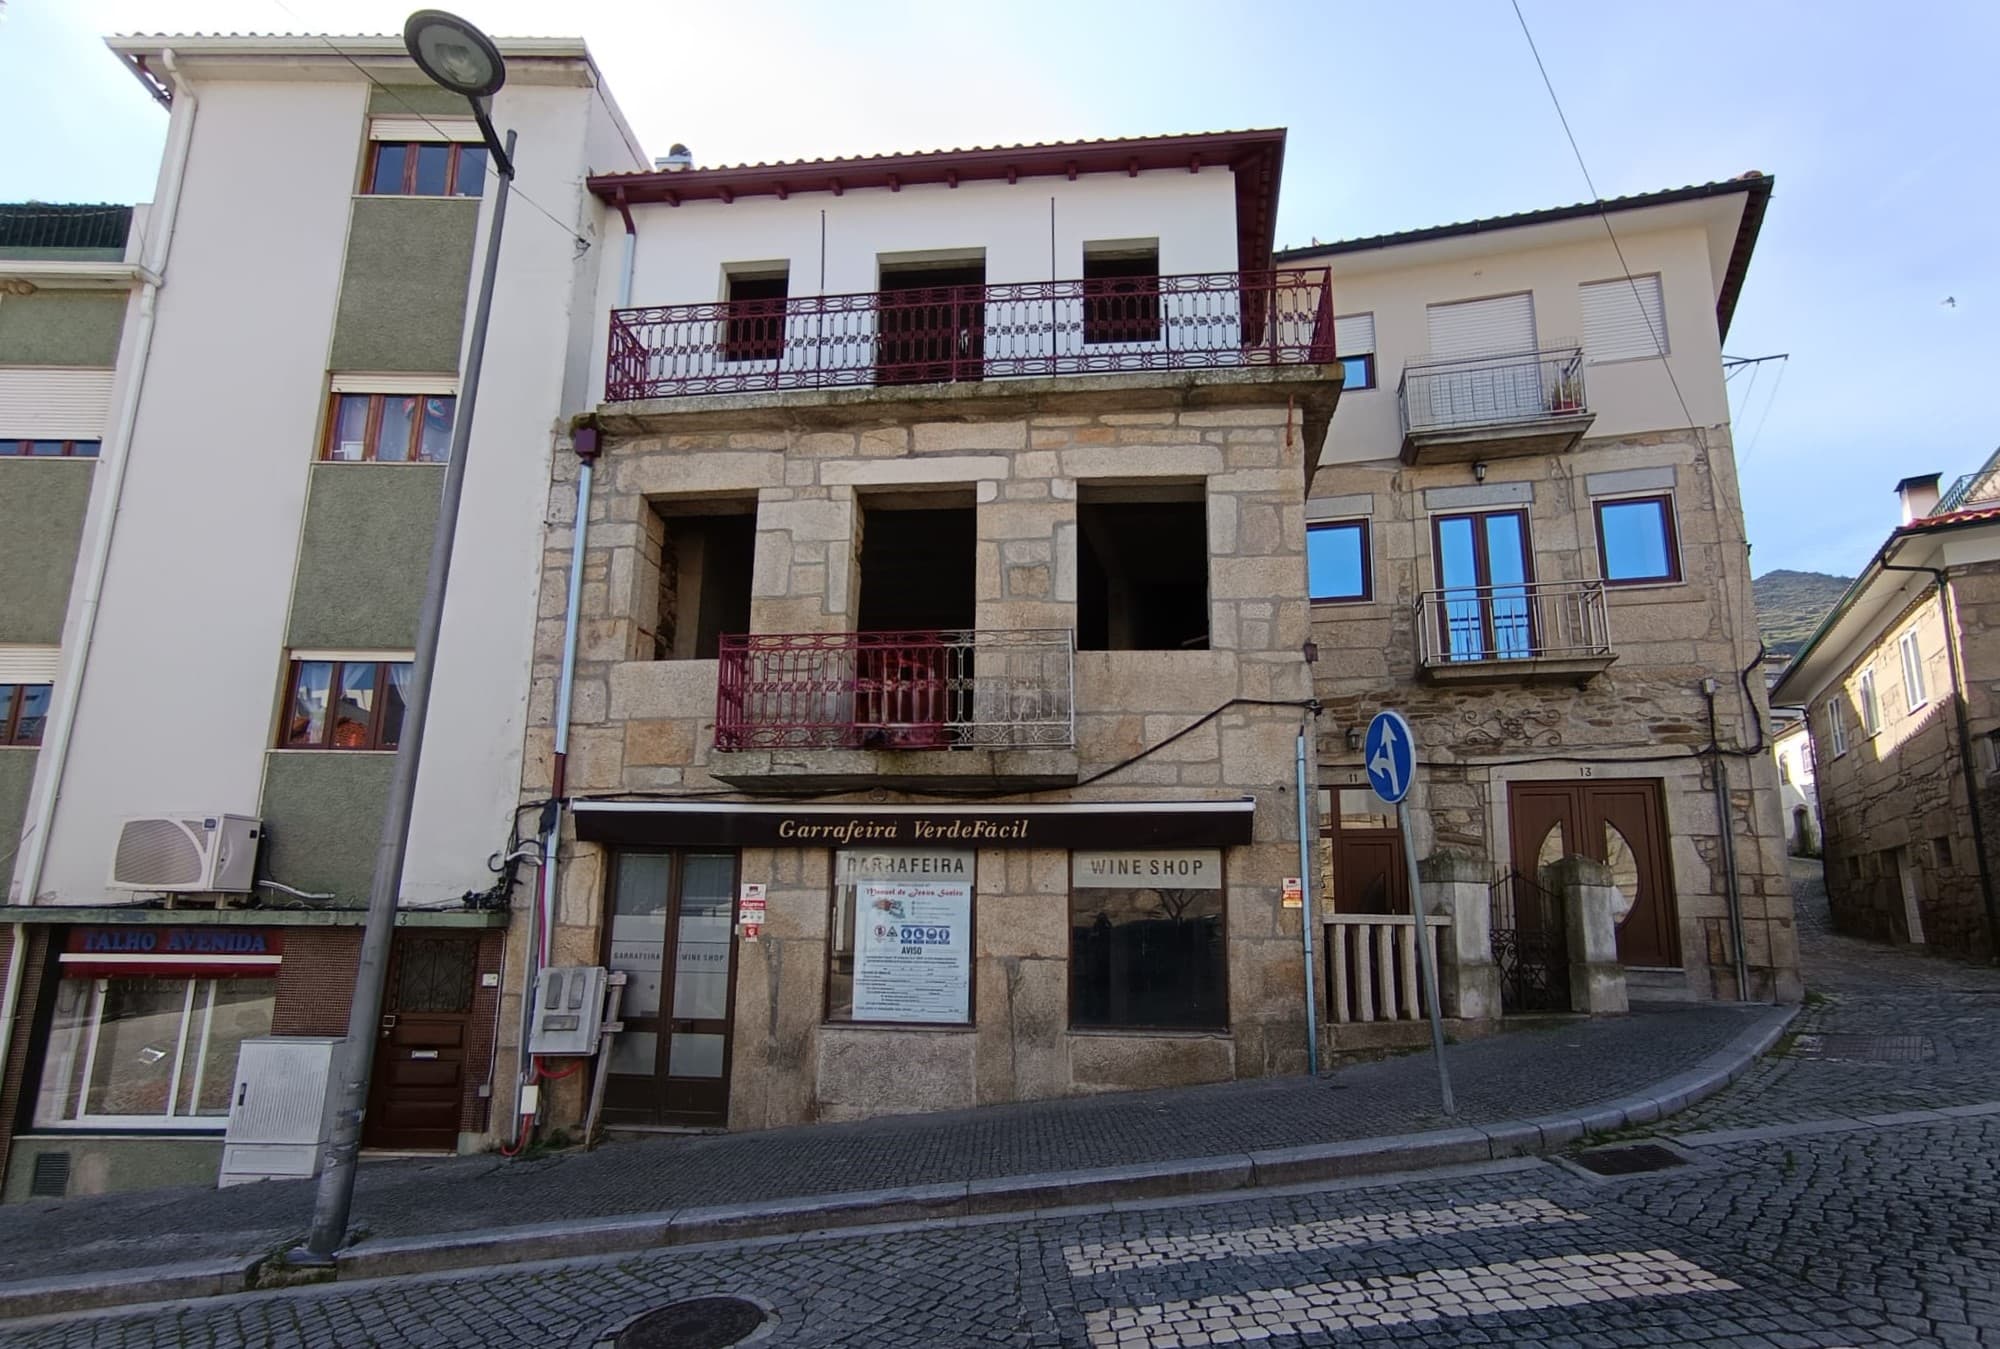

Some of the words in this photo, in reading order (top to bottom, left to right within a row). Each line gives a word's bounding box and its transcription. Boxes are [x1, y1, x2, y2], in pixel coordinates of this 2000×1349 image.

[1579, 767, 1592, 777] 13
[1349, 773, 1358, 783] 11
[779, 820, 898, 844] Garrafeira
[914, 820, 1029, 839] VerdeFácil
[1091, 859, 1142, 875] WINE
[1150, 859, 1204, 876] SHOP
[400, 913, 408, 925] 3
[84, 932, 156, 951] TALHO
[168, 932, 266, 952] AVENIDA
[901, 946, 923, 955] AVISO
[614, 951, 660, 960] GARRAFEIRA
[681, 953, 700, 961] WINE
[703, 954, 725, 962] SHOP
